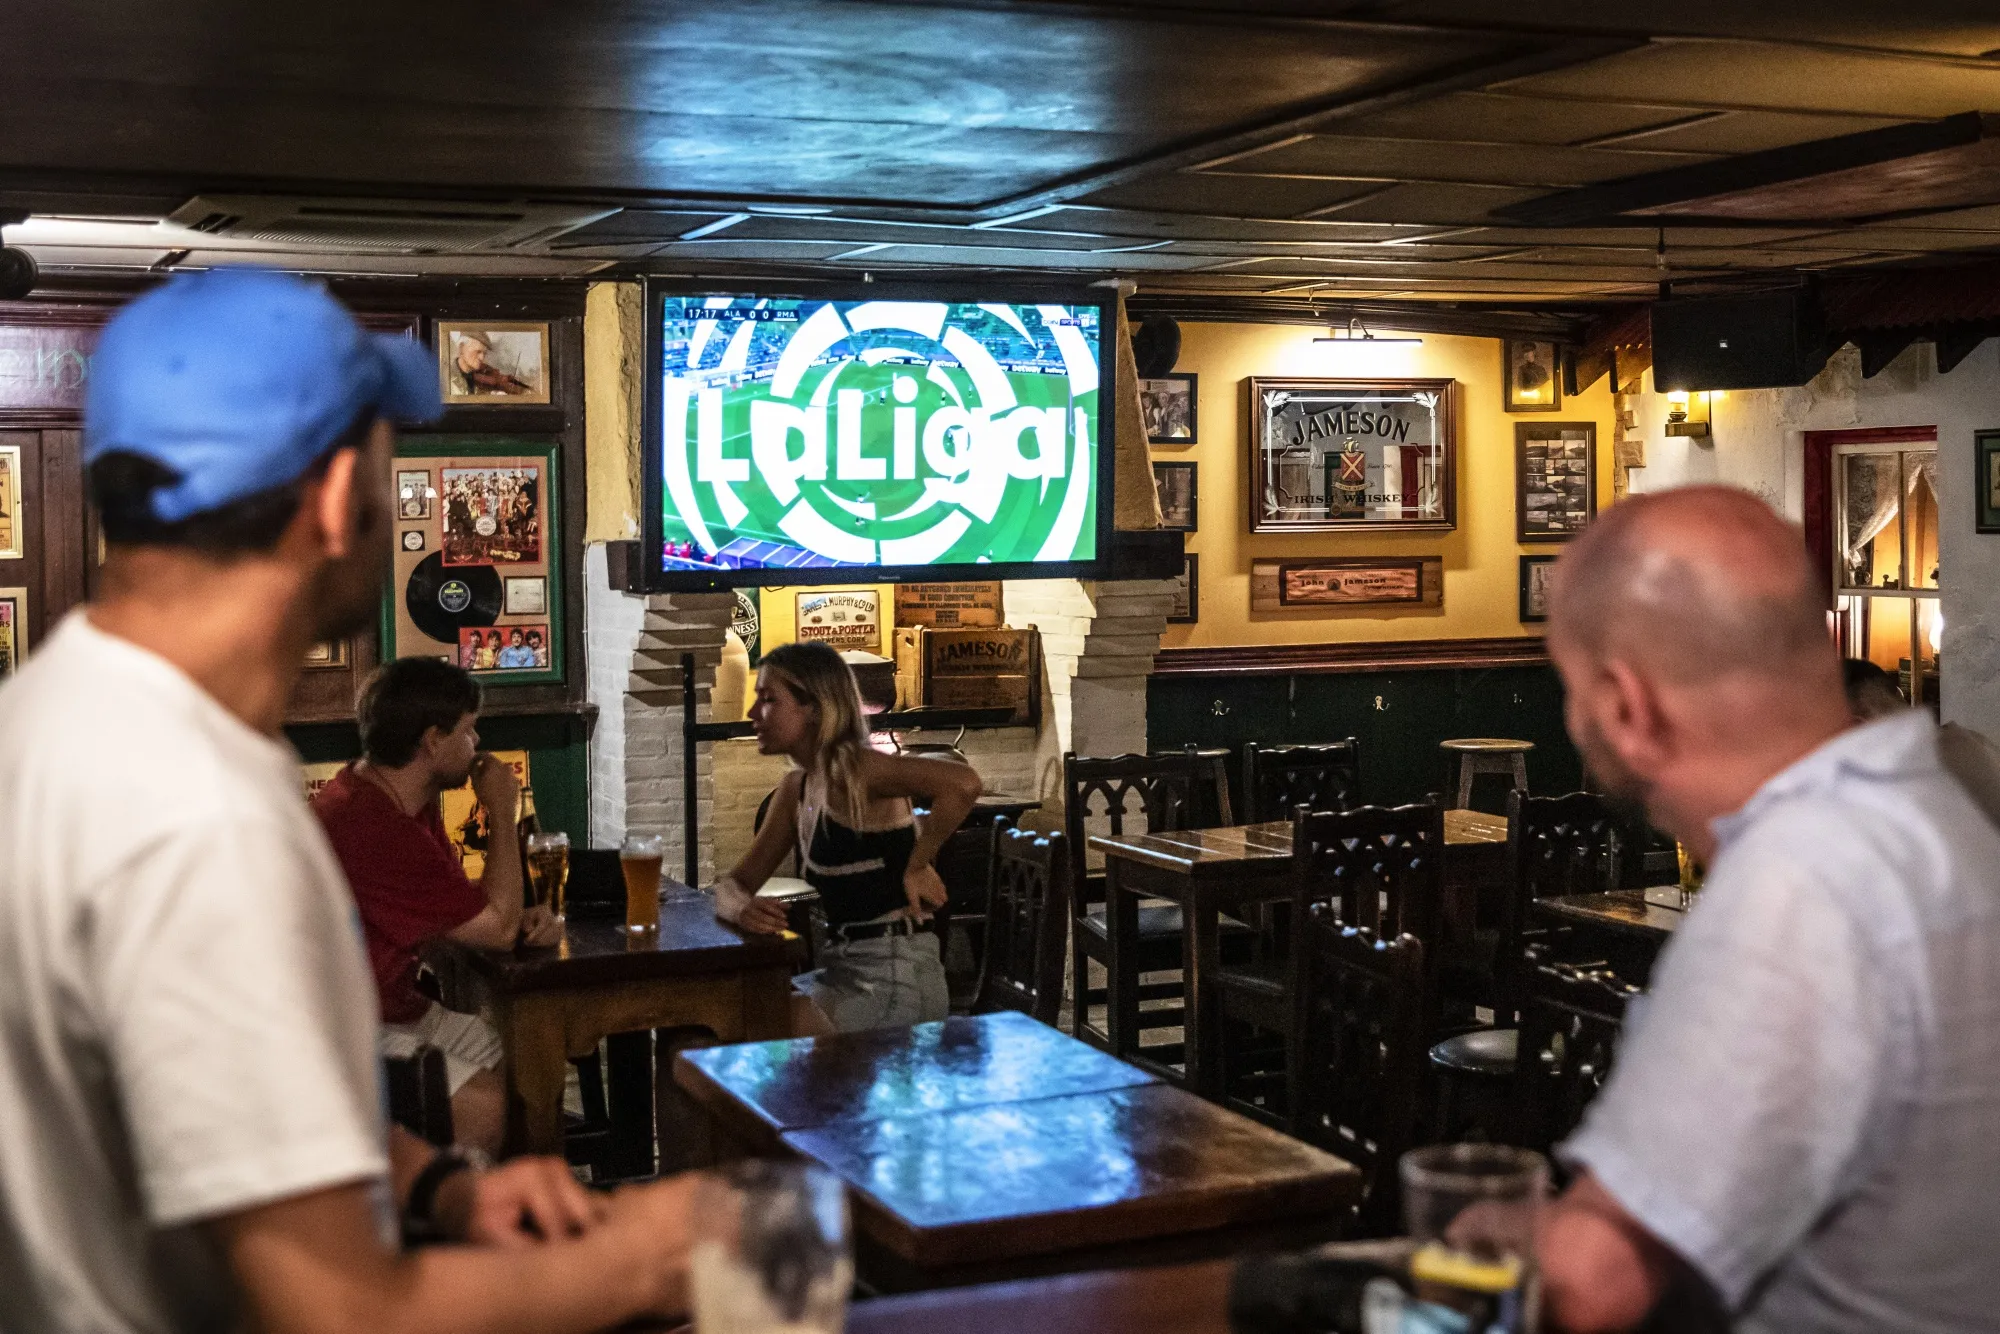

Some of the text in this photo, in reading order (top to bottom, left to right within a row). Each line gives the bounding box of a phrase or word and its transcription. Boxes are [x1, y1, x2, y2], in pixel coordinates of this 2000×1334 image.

[688, 308, 717, 319] 17:17
[749, 310, 756, 319] 0
[763, 310, 769, 319] 0
[776, 310, 795, 318] RMA
[1292, 411, 1411, 446] JAMESON
[697, 375, 1070, 503] LaLiga
[1294, 494, 1410, 505] IRISH WHISKEY
[829, 595, 855, 607] MURPHY
[801, 623, 876, 637] STOUT & PORTER
